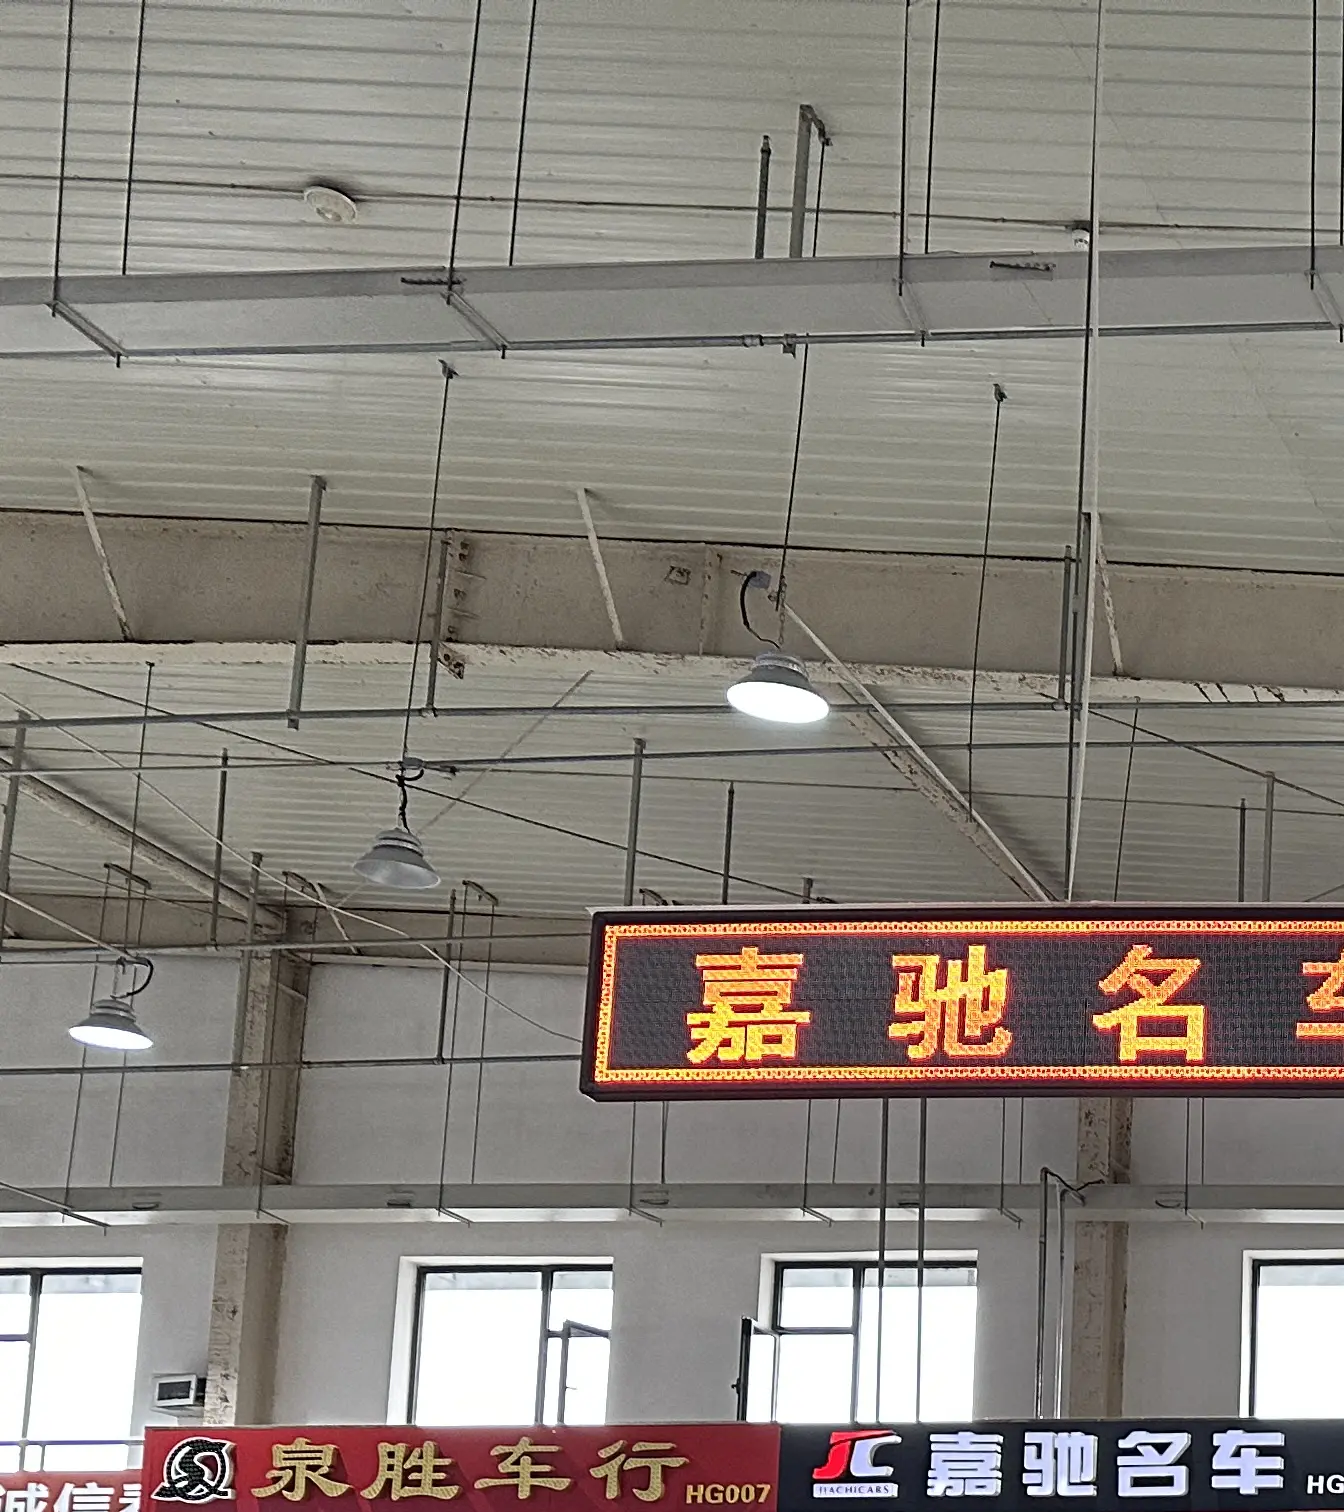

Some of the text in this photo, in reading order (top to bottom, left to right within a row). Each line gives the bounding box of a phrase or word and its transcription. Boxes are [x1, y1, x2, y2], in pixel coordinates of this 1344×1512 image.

[251, 1437, 690, 1502] 泉胜车行
[685, 1483, 771, 1504] HG007
[925, 1430, 1286, 1498] 嘉驰名车
